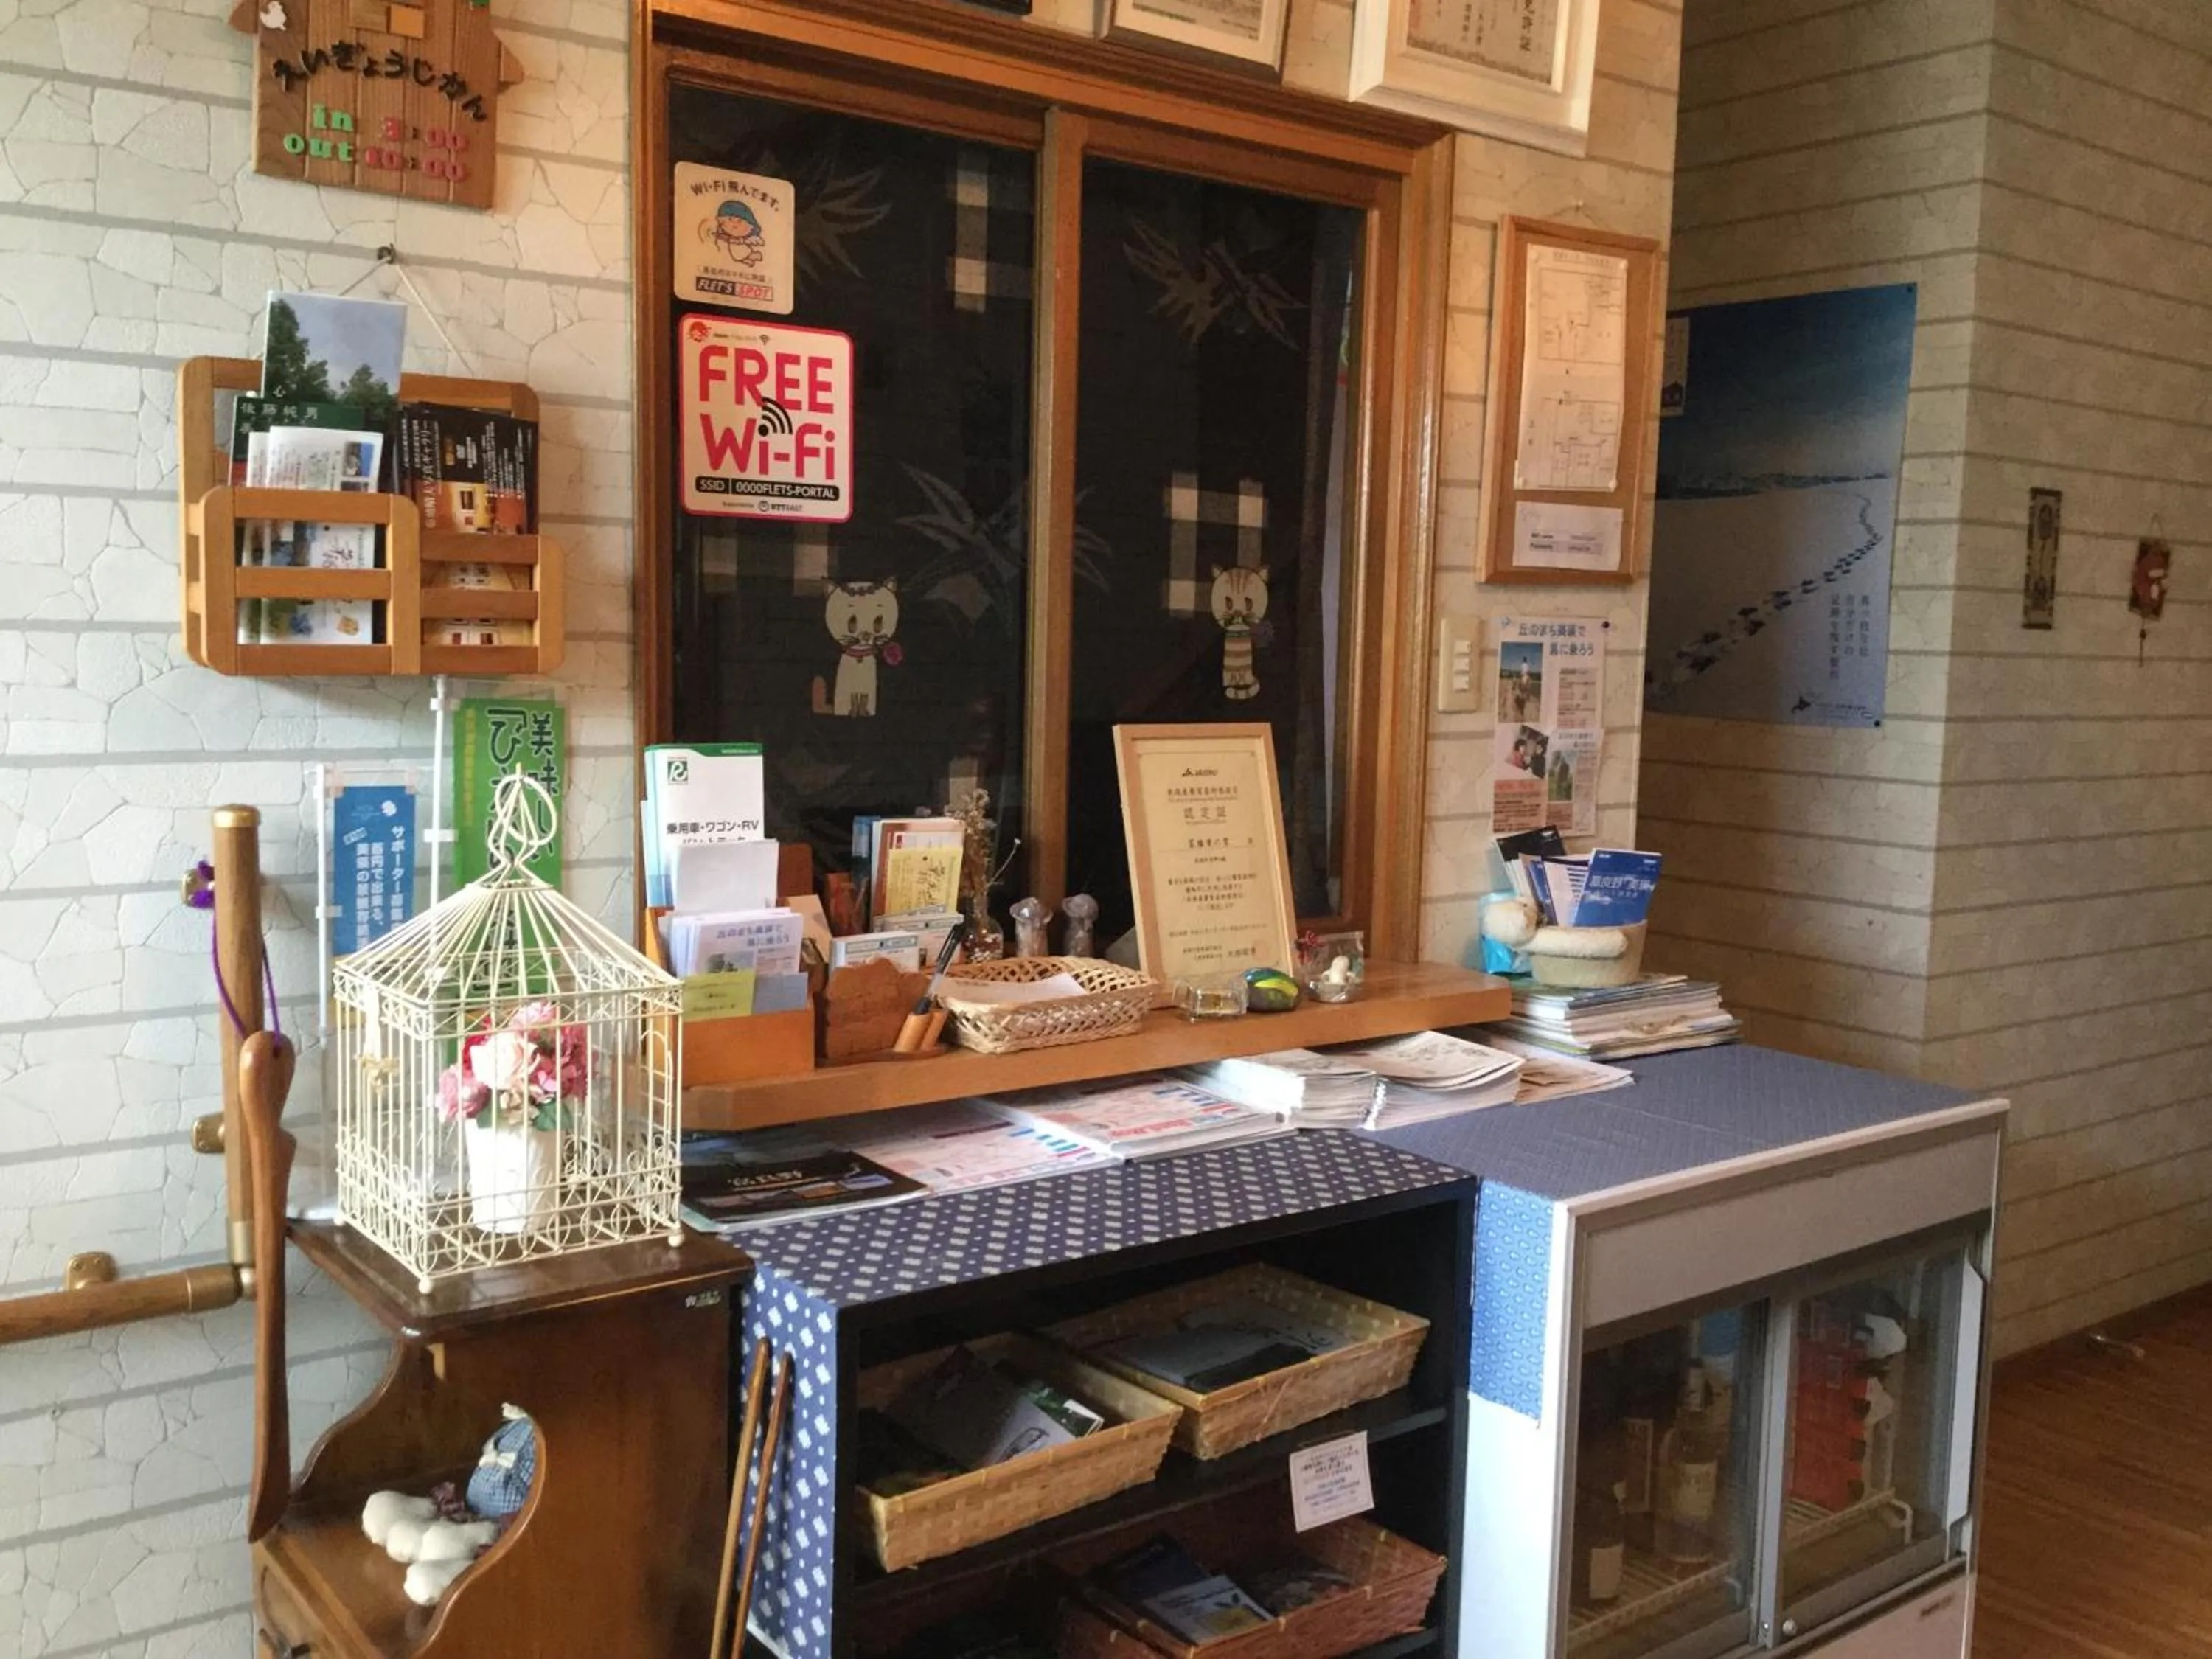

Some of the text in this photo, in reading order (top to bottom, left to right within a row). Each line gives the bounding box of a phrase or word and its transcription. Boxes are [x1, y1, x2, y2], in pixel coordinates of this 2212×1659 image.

[282, 133, 354, 162] out
[699, 344, 835, 414] FREE
[700, 413, 835, 480] Wi-Fi
[700, 480, 724, 491] SSID
